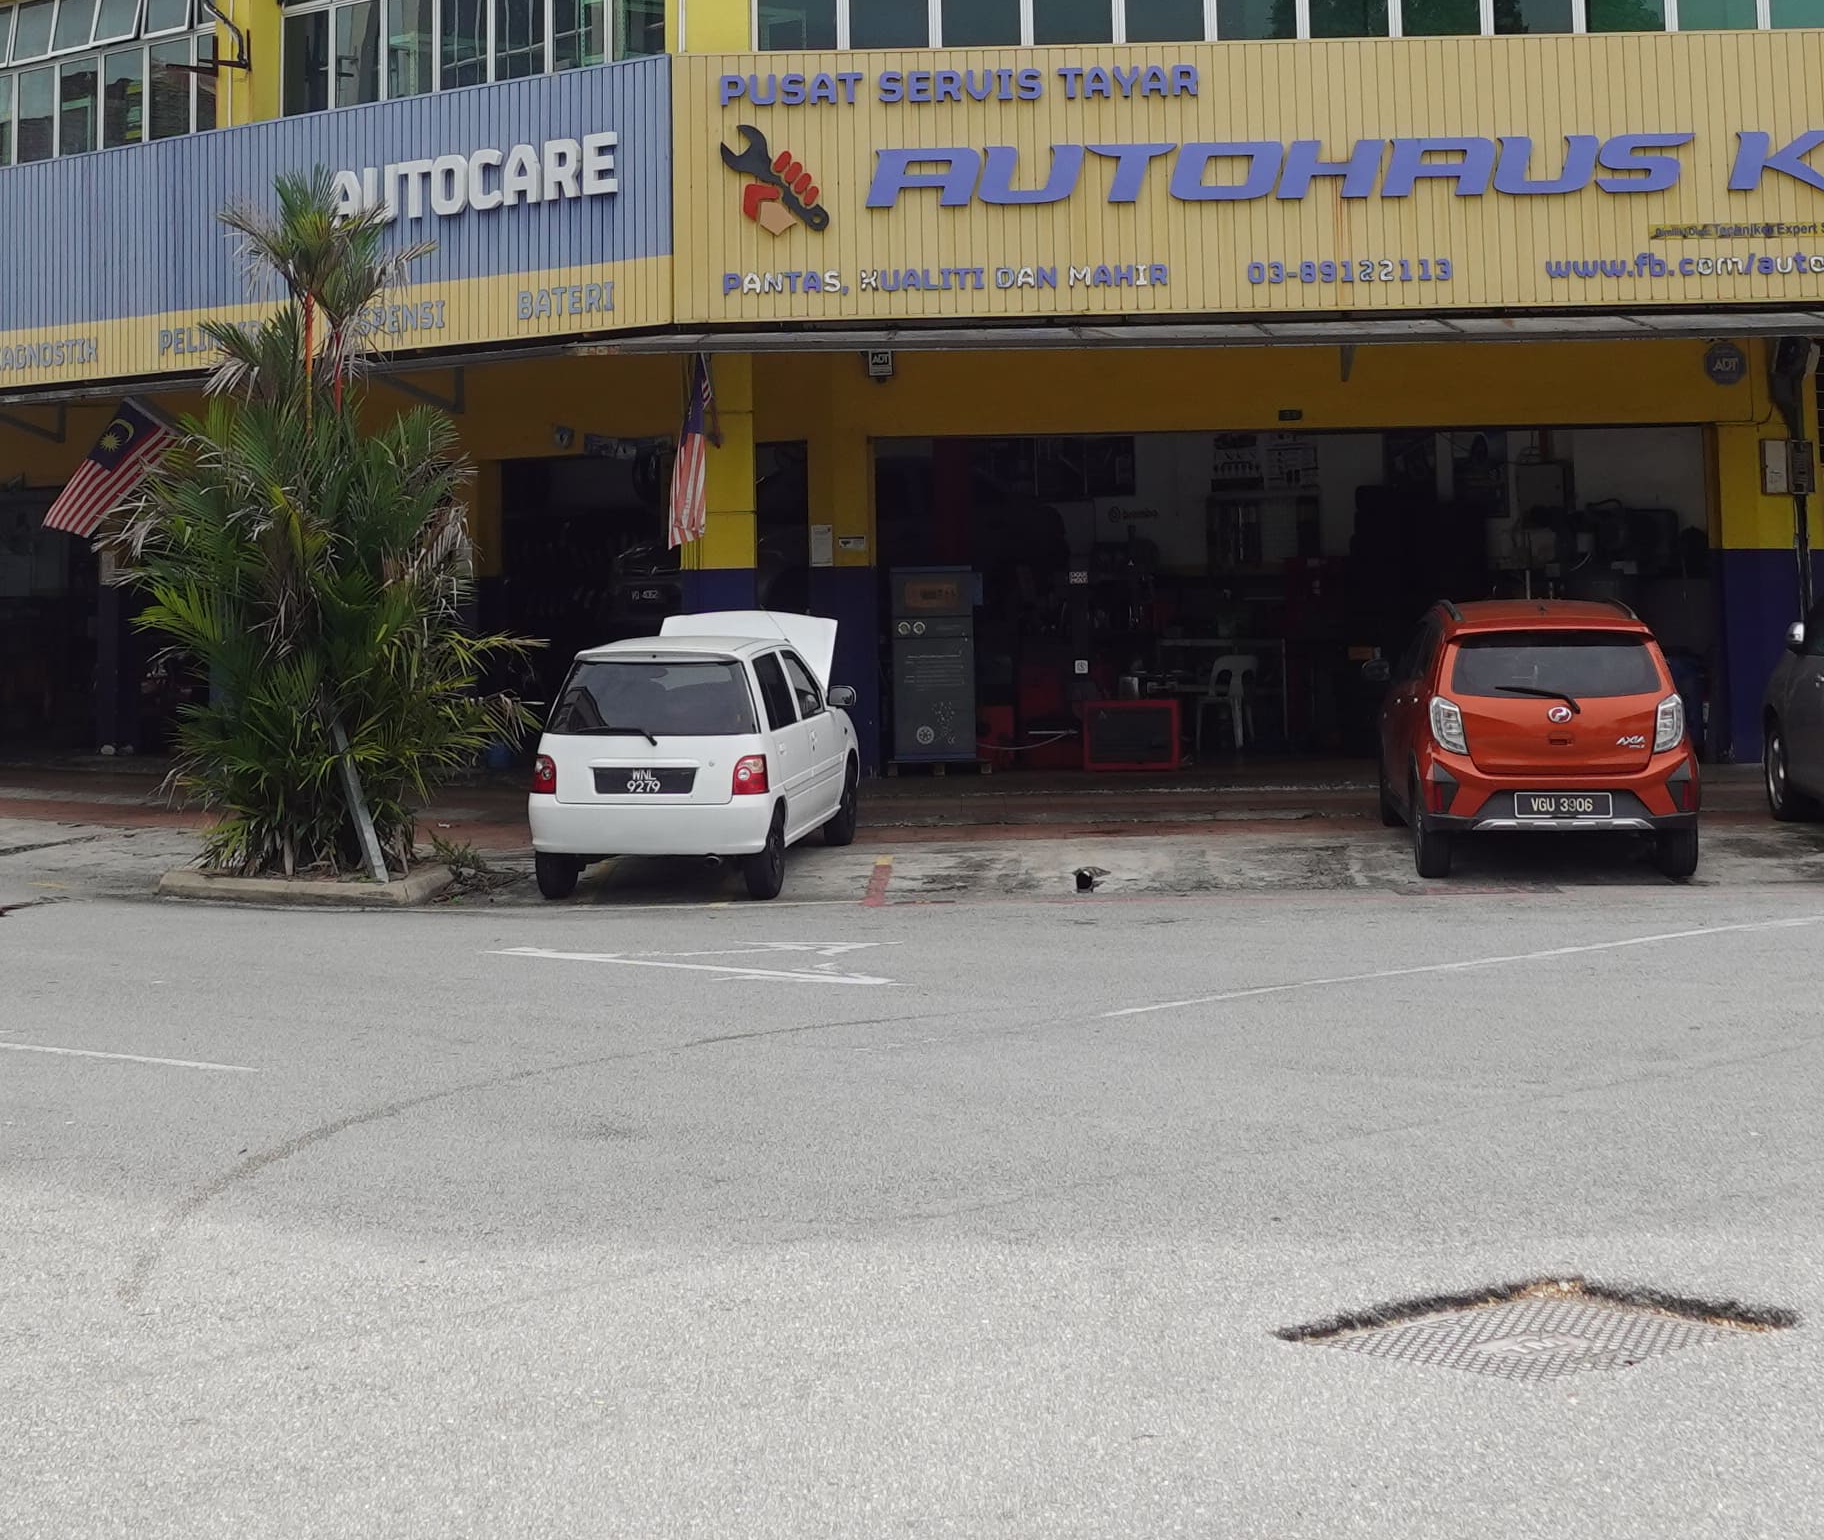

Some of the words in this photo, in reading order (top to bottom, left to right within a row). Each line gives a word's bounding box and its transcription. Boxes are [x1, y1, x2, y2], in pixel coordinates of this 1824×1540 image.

[720, 71, 863, 106] PUSAT
[879, 67, 1044, 104] SERVIS
[1058, 63, 1199, 100] TAYAR
[331, 131, 619, 228] AUTOCARE
[865, 131, 1696, 209] AUTOHAUS
[1777, 222, 1818, 237] Expert
[860, 266, 986, 292] KUALITI
[995, 265, 1058, 290] DAN
[1068, 262, 1169, 288] MAHIR
[1247, 257, 1453, 285] 03-89122113
[517, 280, 615, 322] BATERI
[626, 779, 661, 793] 9279
[631, 768, 657, 780] WNL
[1531, 796, 1556, 812] VGU
[1560, 796, 1593, 812] 3906
